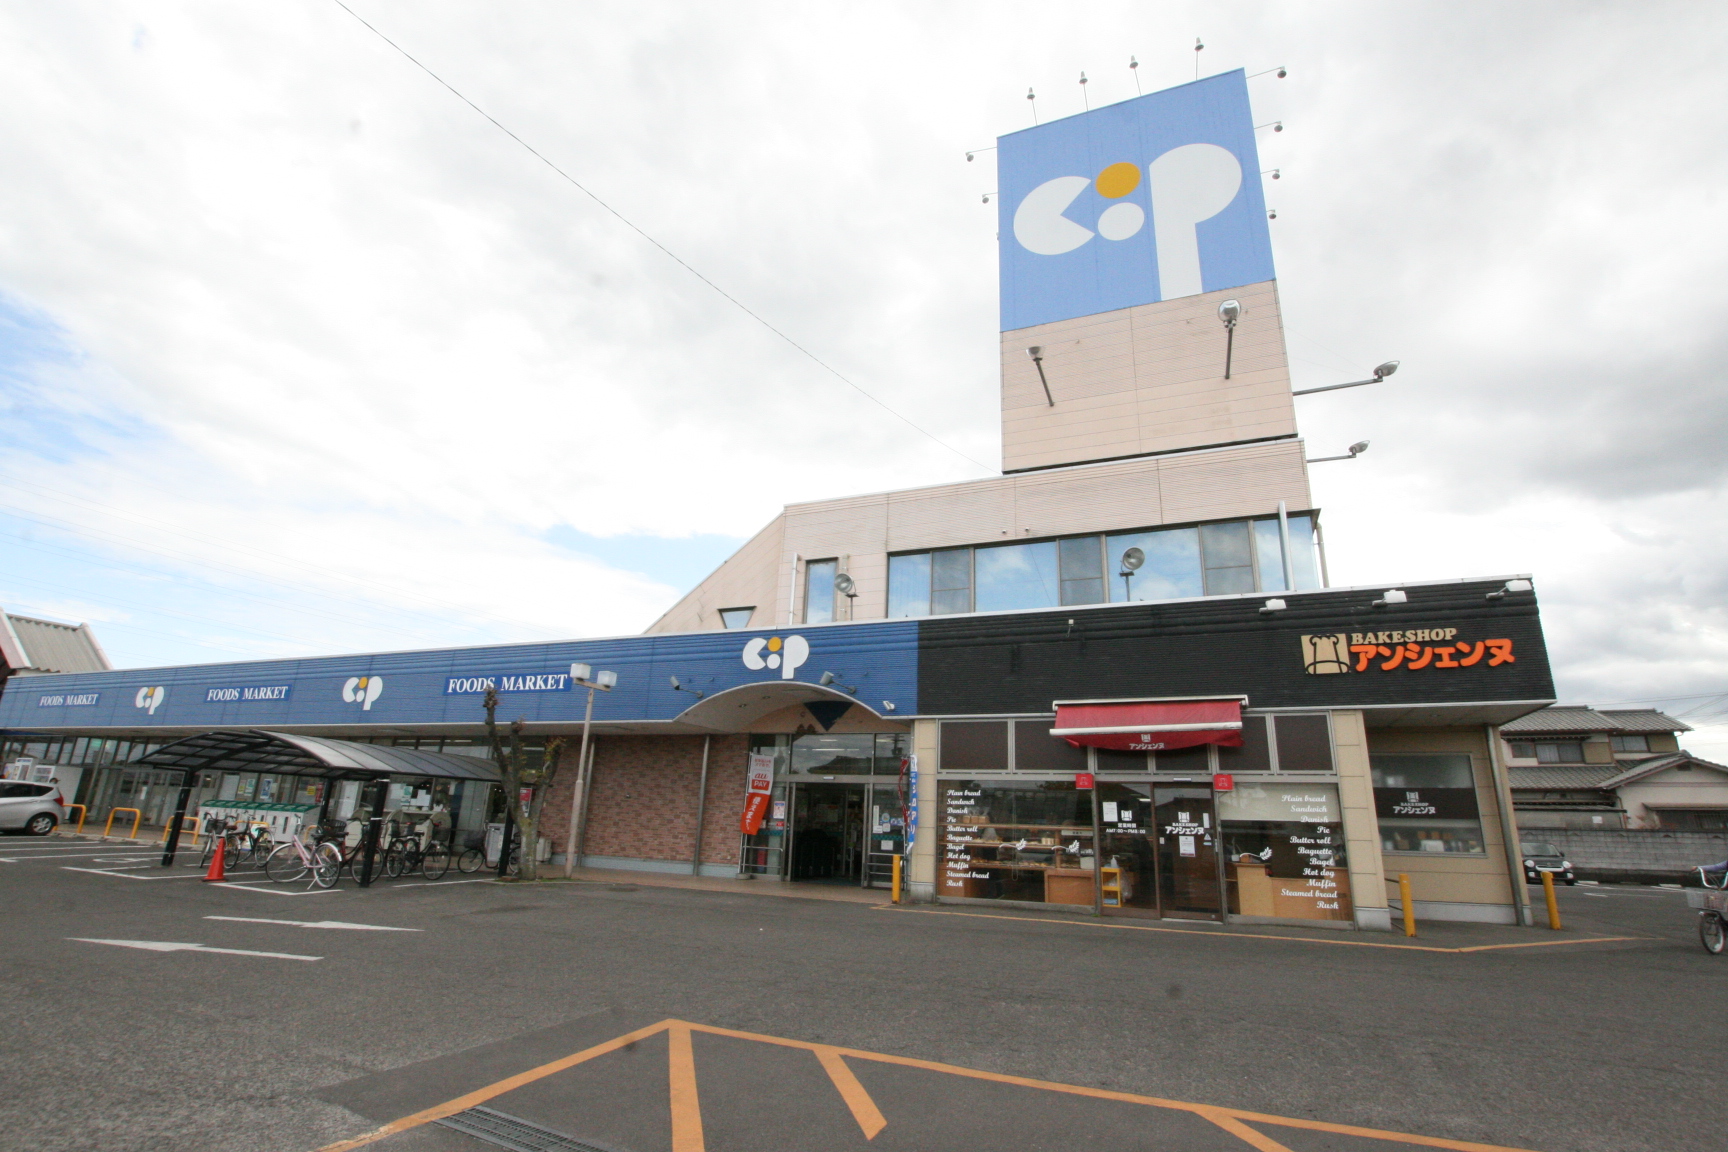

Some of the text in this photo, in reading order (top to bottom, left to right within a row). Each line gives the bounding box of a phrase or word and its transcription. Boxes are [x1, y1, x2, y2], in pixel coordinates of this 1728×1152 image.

[1351, 628, 1457, 645] BAKESHOP
[1350, 638, 1516, 672] アンシェンヌ
[447, 674, 568, 693] FOODS MARKET
[207, 686, 289, 701] FOODS MARKET
[40, 693, 98, 706] FOODS MARKET
[1290, 804, 1328, 812] Sandwich
[1392, 806, 1436, 815] アンシェンヌ
[1300, 815, 1329, 823] Danish
[1164, 826, 1204, 834] アンシェンヌ
[1316, 826, 1330, 834] Pie
[946, 834, 973, 842] Baguette
[1290, 836, 1332, 844] Butter roll
[946, 844, 965, 852] Bagel
[1298, 846, 1332, 856] Baguette
[960, 853, 971, 862] dog
[1309, 857, 1334, 867] Bagel
[946, 862, 969, 870] Muffin
[1302, 868, 1335, 878] Hot dog
[1306, 879, 1336, 889] Muffin
[1280, 888, 1338, 898] Steamed bread
[1316, 900, 1340, 910] Rusk
